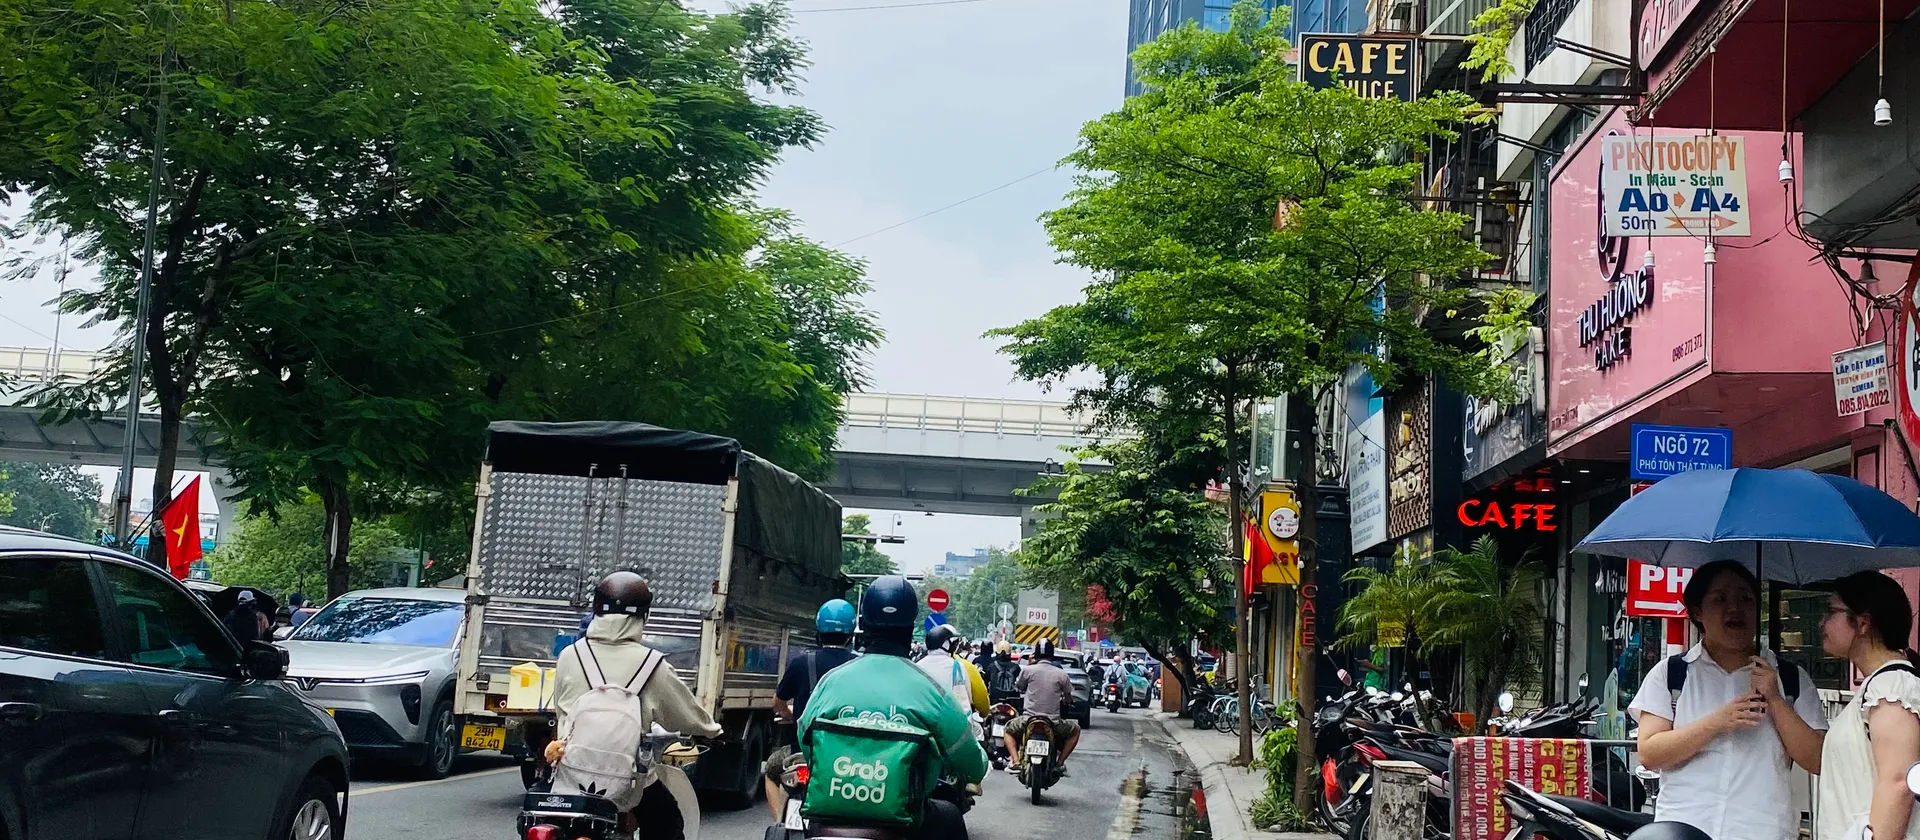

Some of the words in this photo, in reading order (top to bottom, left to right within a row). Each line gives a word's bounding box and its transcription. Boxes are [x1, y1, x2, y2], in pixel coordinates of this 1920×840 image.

[1308, 41, 1407, 75] CAFE
[1629, 173, 1642, 186] In
[1690, 173, 1724, 187] Scan
[1690, 188, 1740, 212] A4
[1621, 216, 1656, 230] 50m
[1577, 301, 1598, 348] THU
[1595, 328, 1625, 370] CAKE
[1875, 367, 1885, 377] FPT
[1852, 381, 1874, 394] CAMERA
[1654, 434, 1688, 454] NGÕ
[1692, 438, 1709, 456] 72
[1640, 455, 1657, 470] PHỐ
[1658, 459, 1675, 471] TÔN
[1458, 500, 1558, 531] CAFE
[1640, 564, 1693, 593] PH
[1028, 611, 1047, 621] P90
[1301, 584, 1317, 647] CAFE
[834, 756, 889, 781] Grab
[1472, 762, 1489, 789] HOẶC
[829, 777, 886, 804] Food
[1475, 808, 1488, 840] 1.000.
